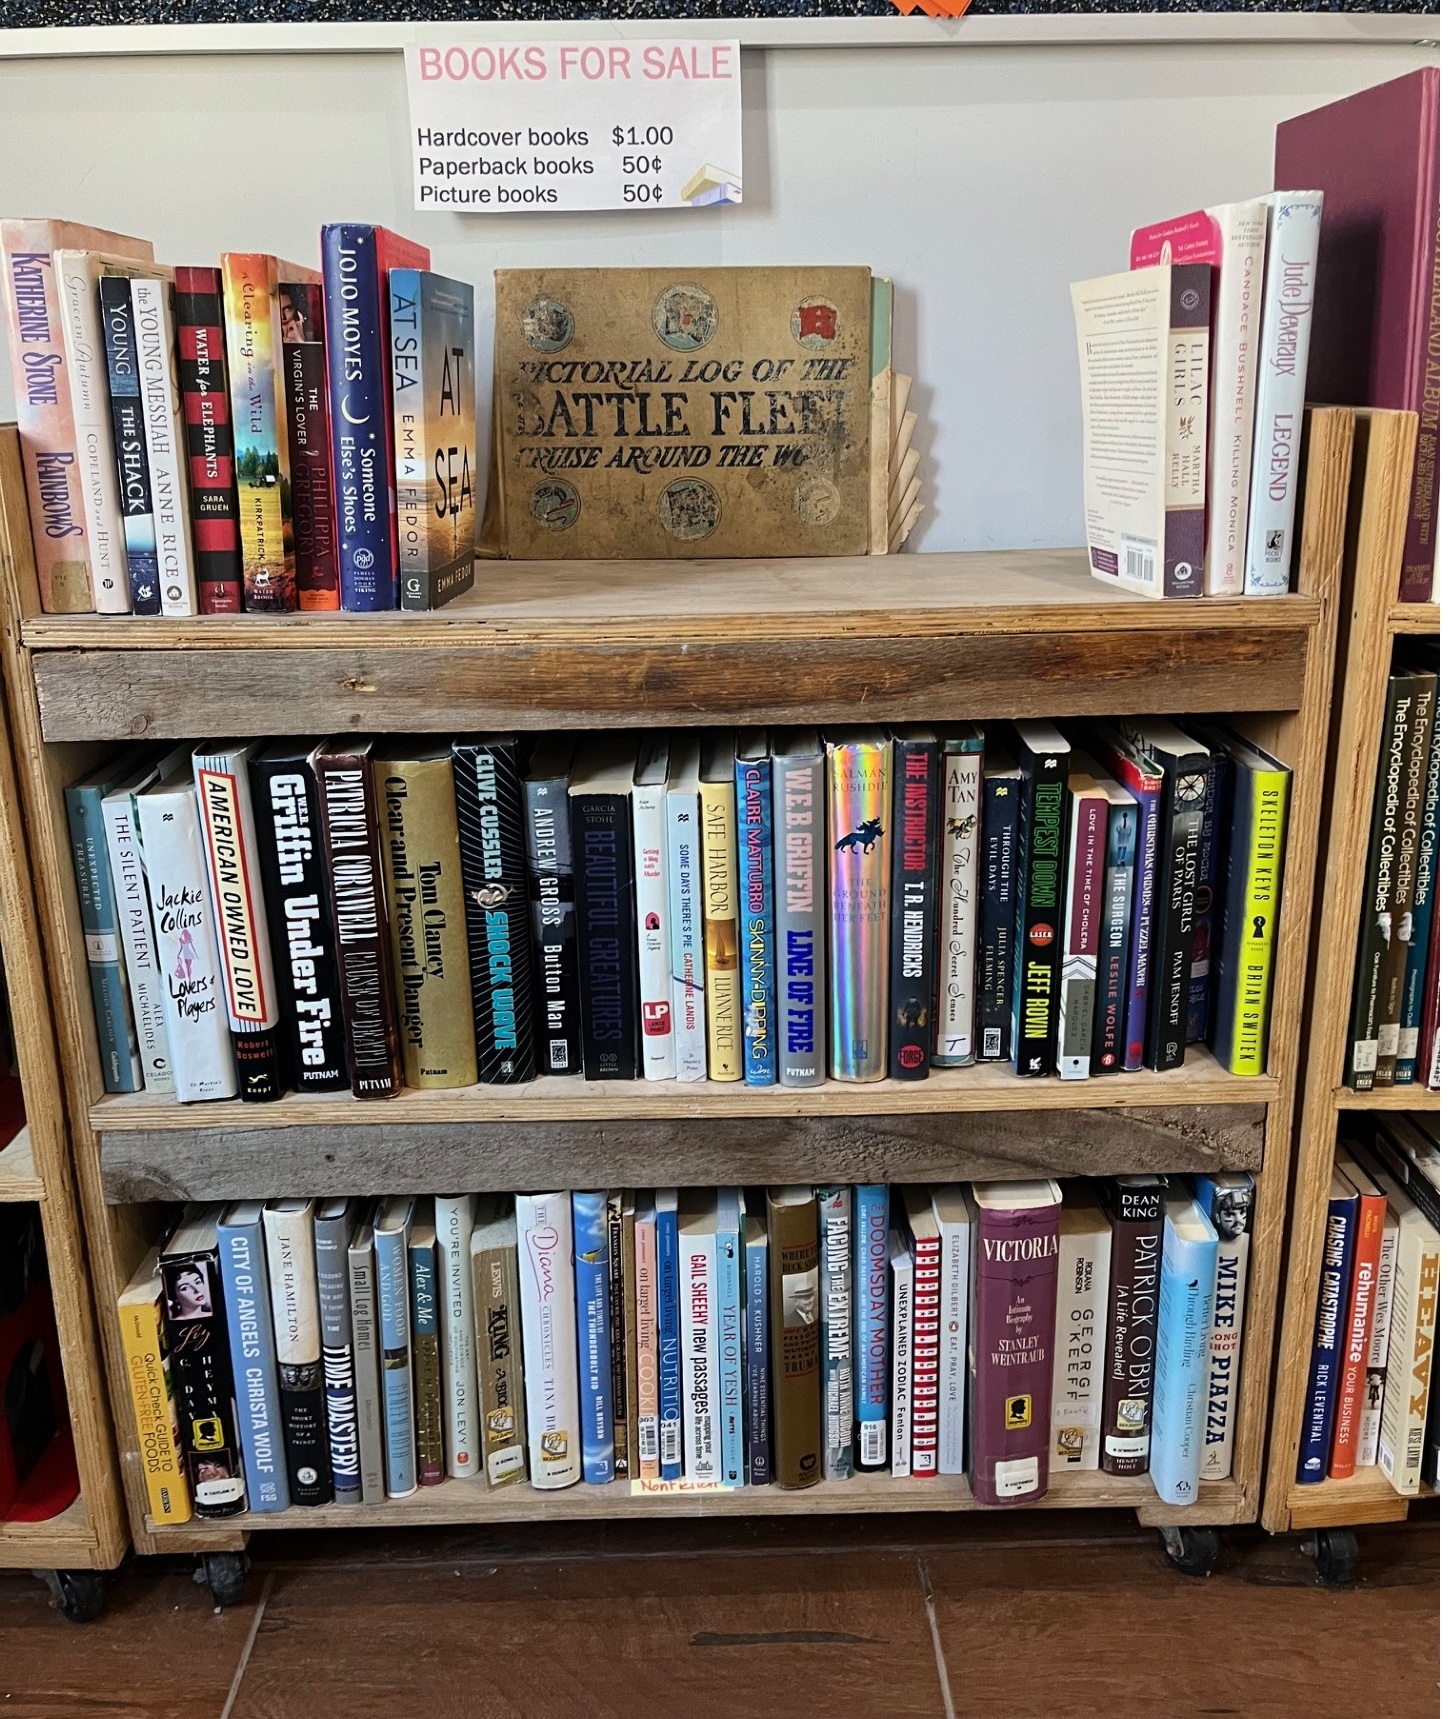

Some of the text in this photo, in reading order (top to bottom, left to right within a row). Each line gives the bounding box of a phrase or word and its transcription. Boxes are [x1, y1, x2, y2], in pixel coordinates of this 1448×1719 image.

[419, 46, 732, 81] BOOKS FOR SALE
[417, 126, 673, 147] Hardcover books $1.00
[419, 156, 662, 179] Paperback books 50¢
[420, 184, 662, 203] Picture books 50¢
[110, 304, 131, 376] YOUNG
[337, 246, 363, 382] JOJO MOYES
[11, 252, 84, 539] KATHERINE STONE RAINBOWS
[195, 329, 219, 479] WATER for ELEPHANTS
[679, 359, 745, 382] LOG
[1226, 256, 1254, 552] CANDACE BUSHNELL KILLING MONICA
[1267, 255, 1312, 502] Jude Deveraux LEGEND
[120, 405, 147, 513] THE SHACK
[137, 287, 178, 578] the YOUNG MESSIAH ANNE RICE
[393, 293, 419, 558] AT SEA EMMA FEDOR
[255, 497, 266, 560] KIRKPATRICK
[339, 436, 356, 533] Else's Shoes
[360, 448, 376, 522] Someone
[745, 769, 761, 824] CLAIRE
[948, 769, 977, 784] AMY
[948, 786, 976, 803] TAN
[1376, 697, 1411, 912] The Encyclopedia of Collectibles
[114, 815, 150, 969] THE SILENT PATIENT
[155, 884, 204, 912] Jackie
[207, 780, 256, 1012] AMERICAN OWNED LOVE
[325, 769, 379, 944] PATRICIA CORNWELL
[475, 754, 517, 1051] CLIVE CUSSLER SHOCK WAVE
[679, 844, 692, 948] SOME DAYS THERE'S PIE
[707, 804, 729, 919] SAFE HARBOR
[785, 832, 813, 913] GRIFFIN
[902, 752, 928, 979] THE INSTRUCTOR T. R. HENDRICKS
[1109, 872, 1127, 947] THE SURGEON
[160, 910, 203, 934] Collins
[270, 774, 331, 1066] Griffin Under Fire
[385, 776, 425, 1048] Clear and Present Danger
[418, 861, 445, 980] Tom Clancy
[534, 808, 566, 1029] ANDREW GROSS Button Man
[787, 930, 813, 976] LINE
[1239, 790, 1279, 1061] SKELETON KEYS BRIAN SWITEK
[168, 973, 208, 1000] Lovers
[178, 999, 216, 1023] Players
[788, 981, 813, 1005] OF
[788, 1008, 813, 1053] FIRE
[303, 1069, 339, 1080] PUTNAM
[786, 1067, 816, 1077] PUTNAM
[983, 1235, 1058, 1263] VICTORIA
[1122, 1194, 1160, 1206] DEAN
[1123, 1207, 1157, 1218] KING
[277, 1236, 298, 1342] JANE HAMILTON
[449, 1207, 467, 1445] YOU'RE INVITED JON LEVY
[690, 1255, 709, 1414] GAIL SHEEHY new passages
[870, 1216, 885, 1404] DOOMSDAY MOTHER
[1310, 1216, 1346, 1443] CHASING CATASTROPHE RICK LEVENTHAL
[1349, 1262, 1373, 1362] rehumanize
[1371, 1236, 1394, 1363] The Other Wes Moore
[1408, 1253, 1440, 1419] HEAVY
[231, 1236, 274, 1473] CITY OF ANGELS CHRISTA WOLF
[897, 1284, 907, 1402] UNEXPLAINED ZODIAC
[992, 1350, 1045, 1367] WEINTRAUB
[999, 1336, 1039, 1352] STANLEY
[1205, 1257, 1238, 1444] MIKE PIAZZA
[323, 1345, 358, 1475] TIME MASTERY
